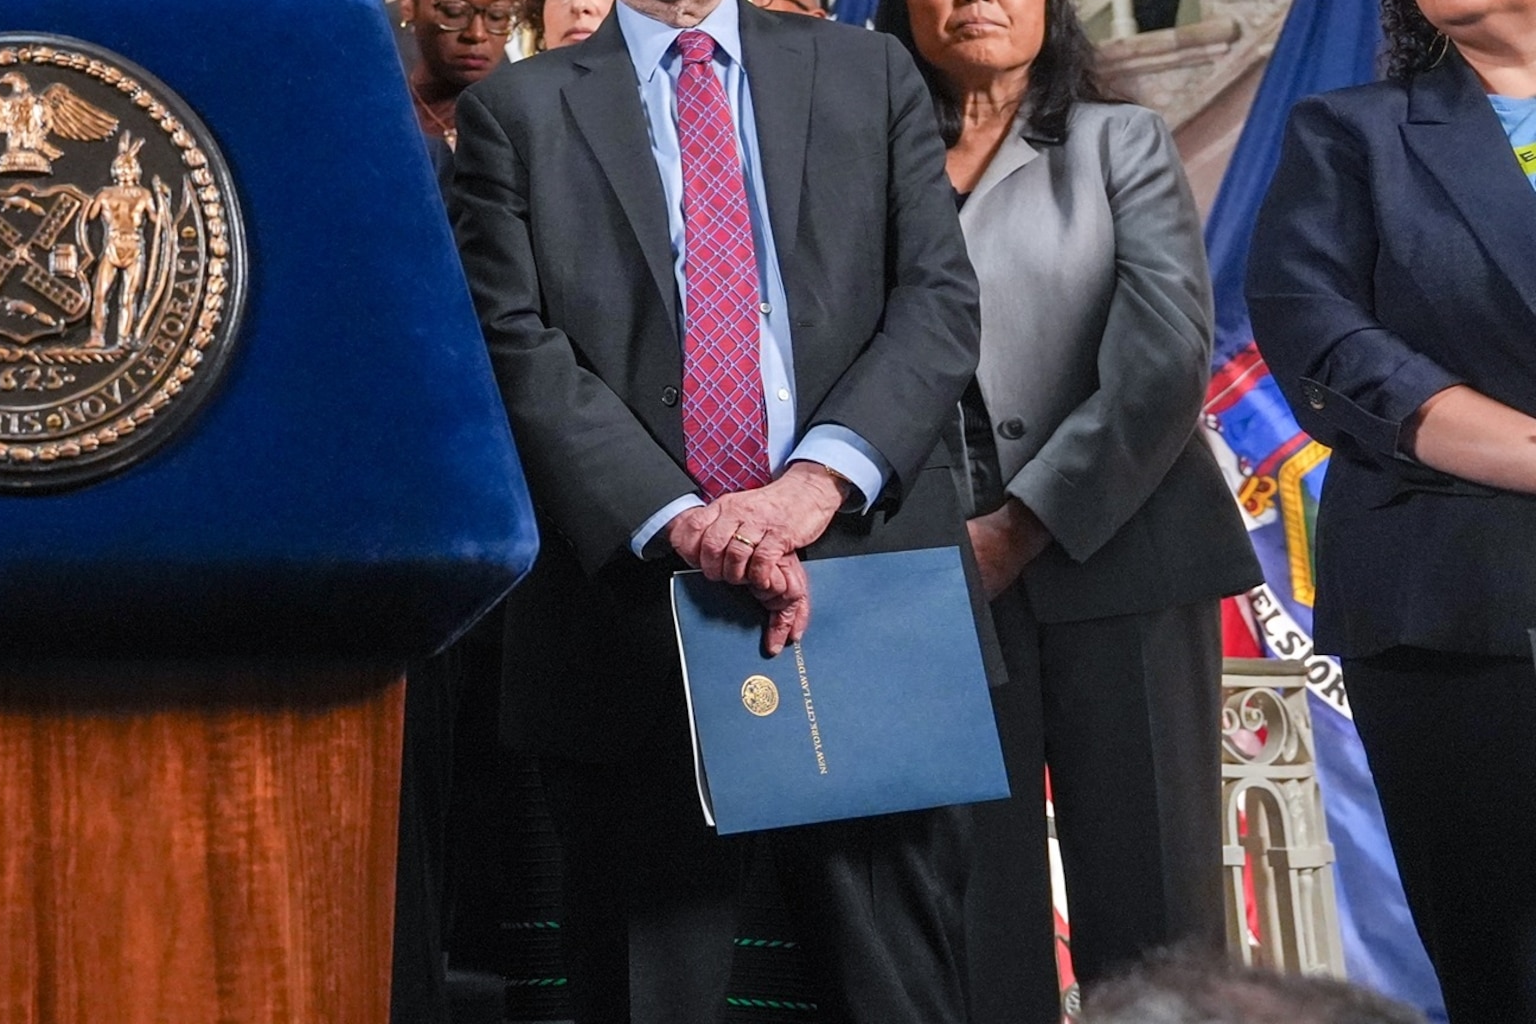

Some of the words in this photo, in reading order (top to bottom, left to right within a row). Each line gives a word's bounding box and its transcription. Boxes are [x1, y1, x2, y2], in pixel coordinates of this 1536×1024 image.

[799, 675, 811, 697] LAW
[804, 697, 817, 722] CITY
[810, 722, 822, 751] YORK
[815, 750, 828, 775] NEW
